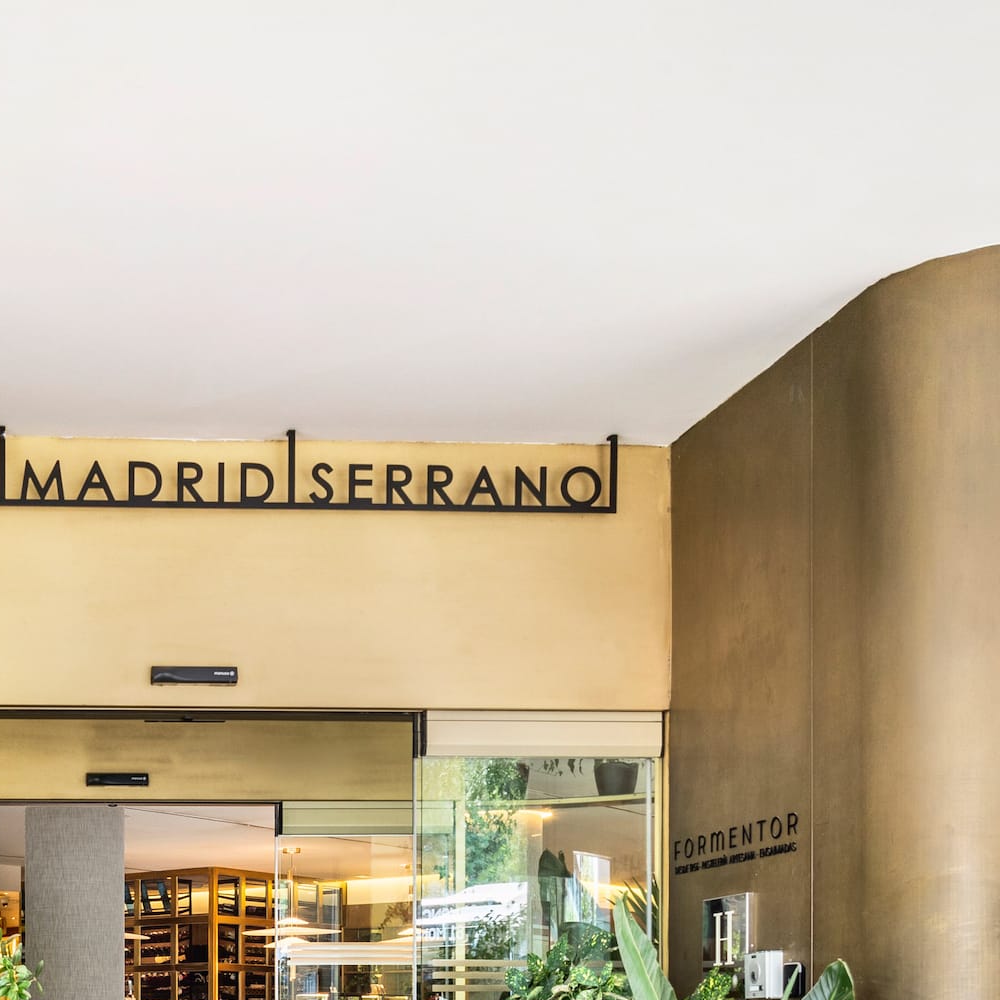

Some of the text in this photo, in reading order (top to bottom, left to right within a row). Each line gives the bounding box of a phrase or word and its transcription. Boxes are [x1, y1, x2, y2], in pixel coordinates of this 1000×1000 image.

[20, 459, 275, 504] MADRID
[308, 462, 602, 509] SERRANO
[673, 812, 799, 861] FORMENTOR
